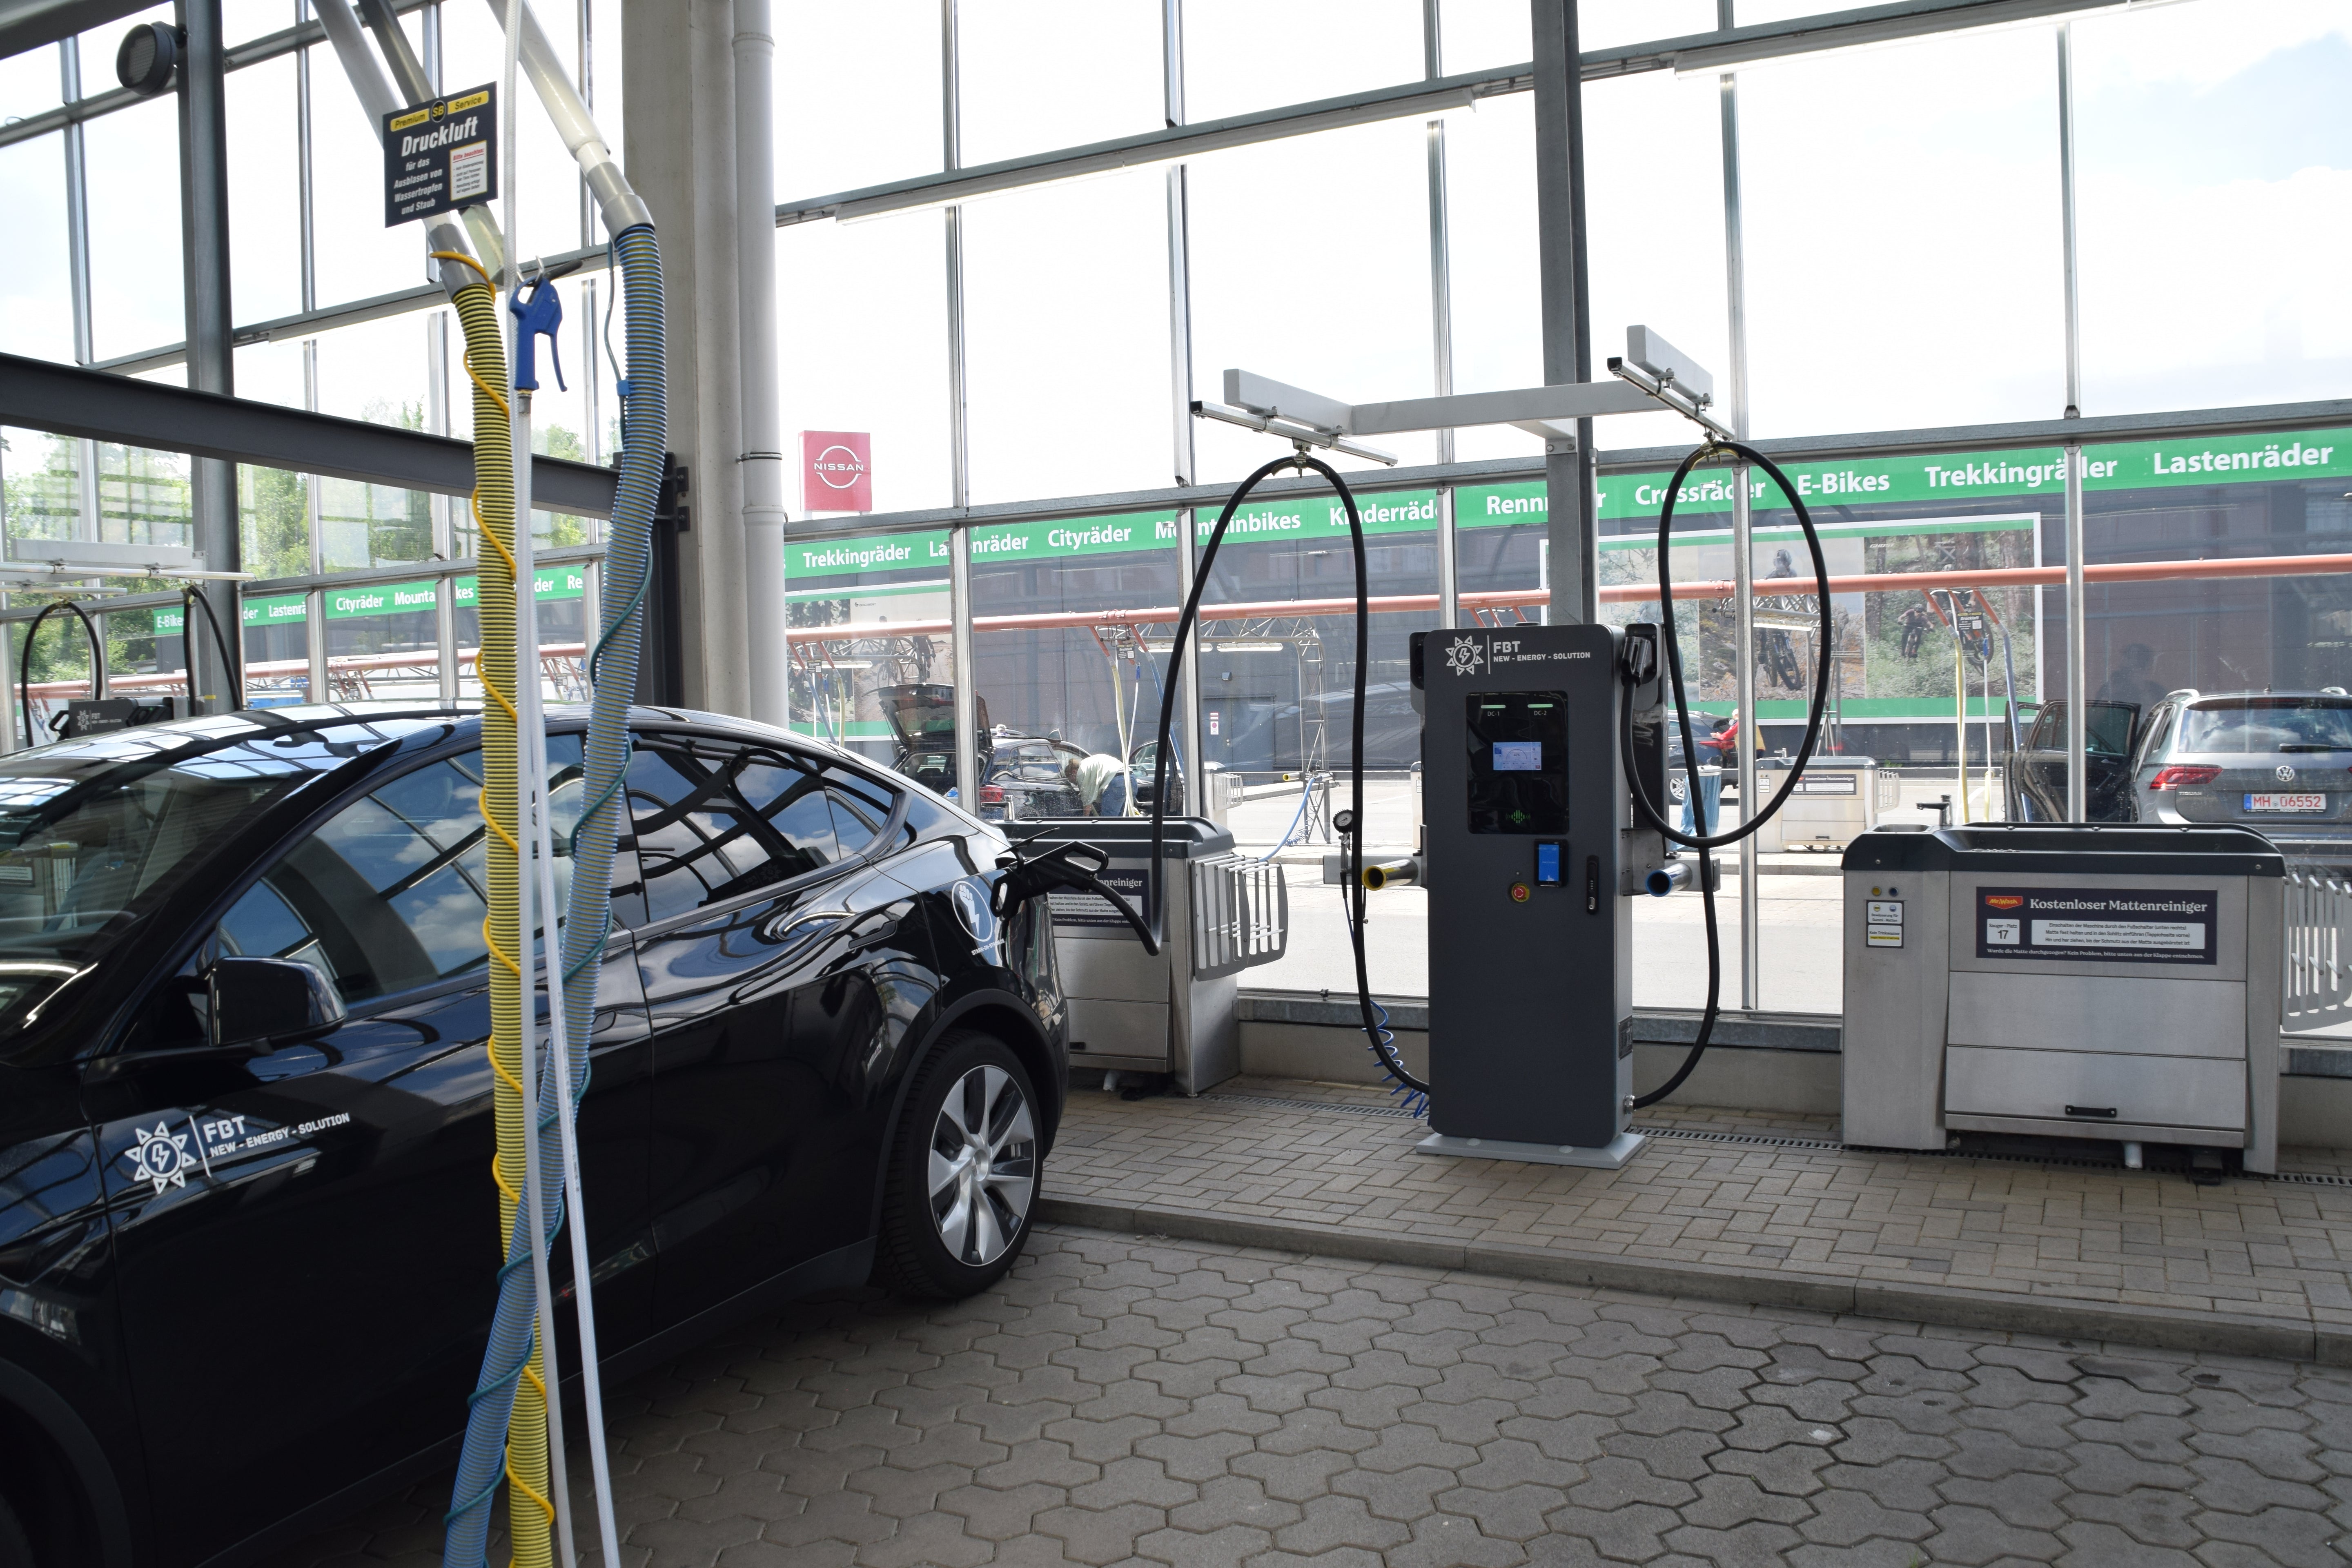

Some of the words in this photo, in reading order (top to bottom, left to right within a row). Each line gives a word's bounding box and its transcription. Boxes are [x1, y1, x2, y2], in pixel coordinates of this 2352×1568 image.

[395, 114, 425, 128] Premium
[432, 106, 445, 117] SB
[454, 96, 482, 110] Service
[401, 116, 478, 157] Druckluft
[406, 161, 416, 171] für
[417, 158, 430, 168] das
[394, 173, 428, 189] Ausblasen
[430, 169, 442, 178] von
[394, 183, 443, 203] Wassertropfen
[401, 203, 414, 215] und
[416, 198, 436, 211] Staub
[814, 463, 864, 471] NISSAN
[802, 546, 911, 568] Trekkingräder
[929, 533, 1029, 557] Lanräder
[1048, 526, 1131, 550] Cityräder
[1155, 512, 1301, 539] Mntinbikes
[1330, 499, 1437, 526] Kiderräd
[1487, 492, 1606, 515] Rennr
[1635, 479, 1766, 505] Crssrär
[1797, 471, 1890, 495] E-Bikes
[2154, 443, 2334, 475] Lastenräder
[269, 601, 306, 617] Lastenrä
[336, 595, 384, 612] Cityräder
[157, 614, 184, 628] E-Bike
[1493, 641, 1521, 653] FBT
[1553, 652, 1590, 660] SOLUTION
[2253, 796, 2270, 807] MH
[2280, 796, 2321, 807] 06552
[1099, 878, 1143, 888] nreiniger
[2030, 899, 2107, 910] Kostenloser
[2109, 900, 2207, 914] Mattenreiniger
[1998, 930, 2009, 939] 17
[203, 1116, 246, 1142] FBT
[209, 1141, 236, 1158] NEW
[246, 1126, 290, 1148] ENERGY
[298, 1112, 351, 1135] SOLUTION
